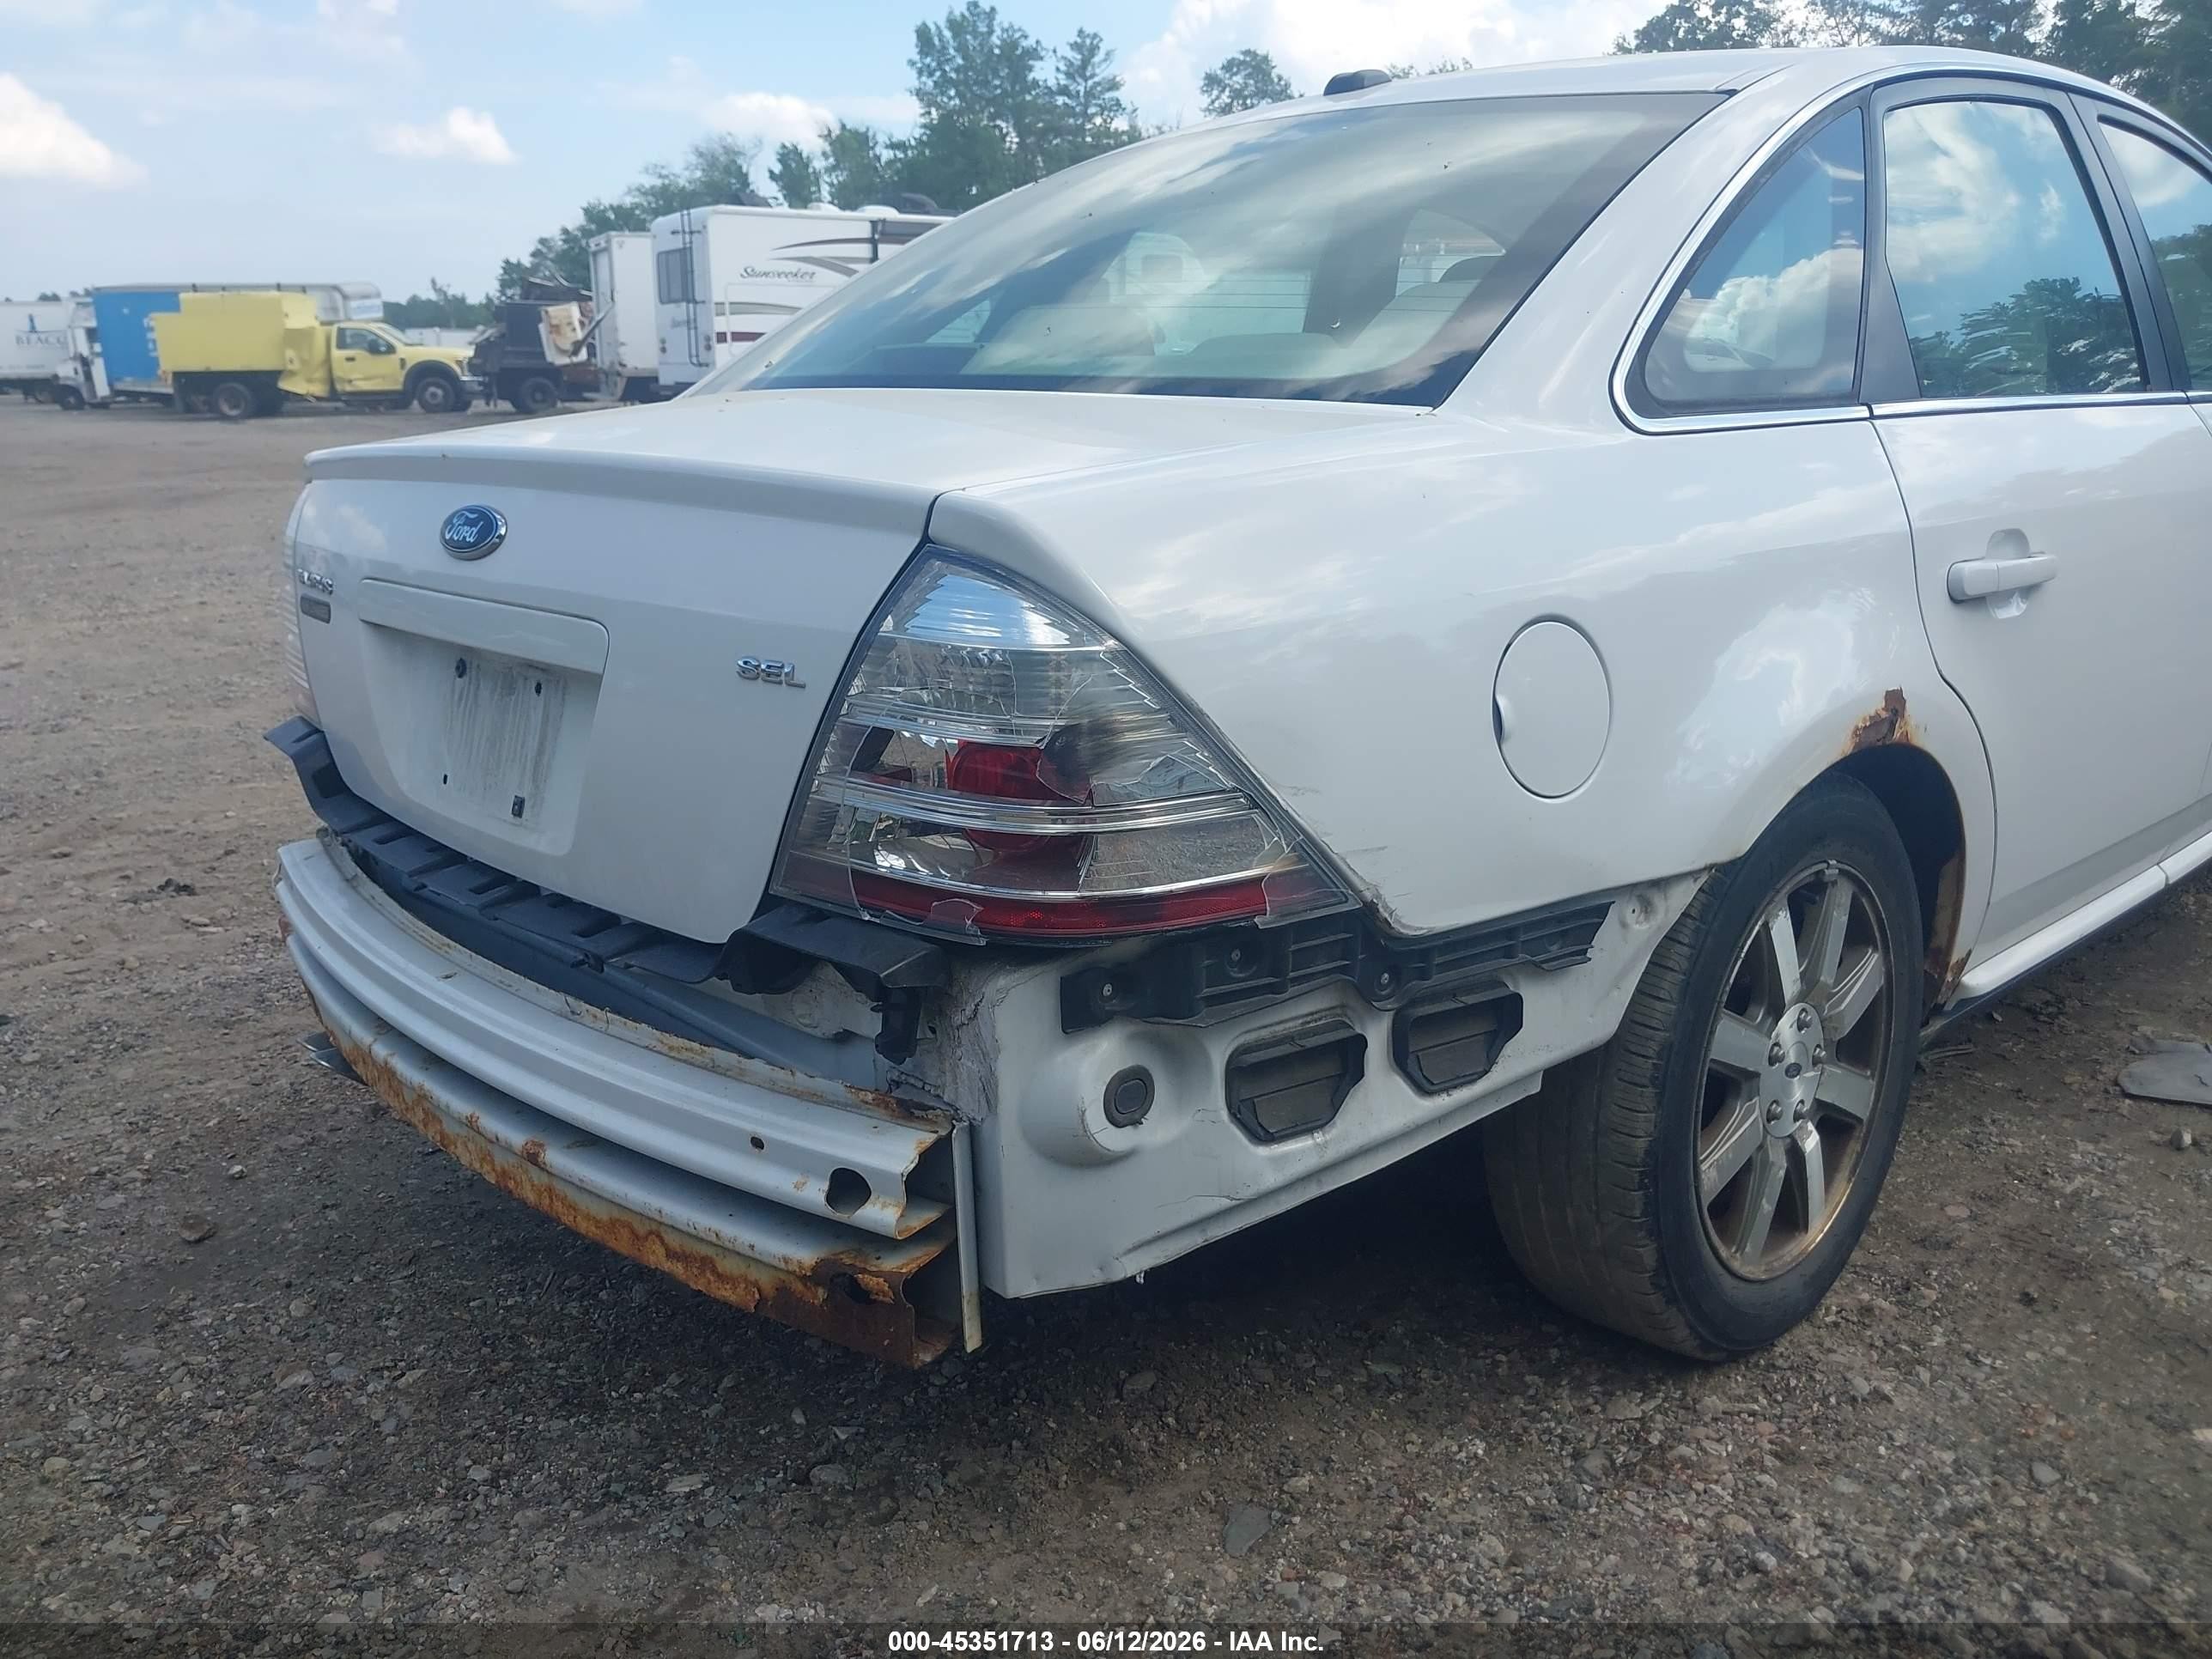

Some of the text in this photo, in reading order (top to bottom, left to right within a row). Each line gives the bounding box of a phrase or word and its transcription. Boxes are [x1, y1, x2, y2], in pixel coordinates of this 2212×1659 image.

[739, 265, 817, 279] Sunseeker
[445, 511, 483, 543] Ford
[736, 655, 806, 689] SEL
